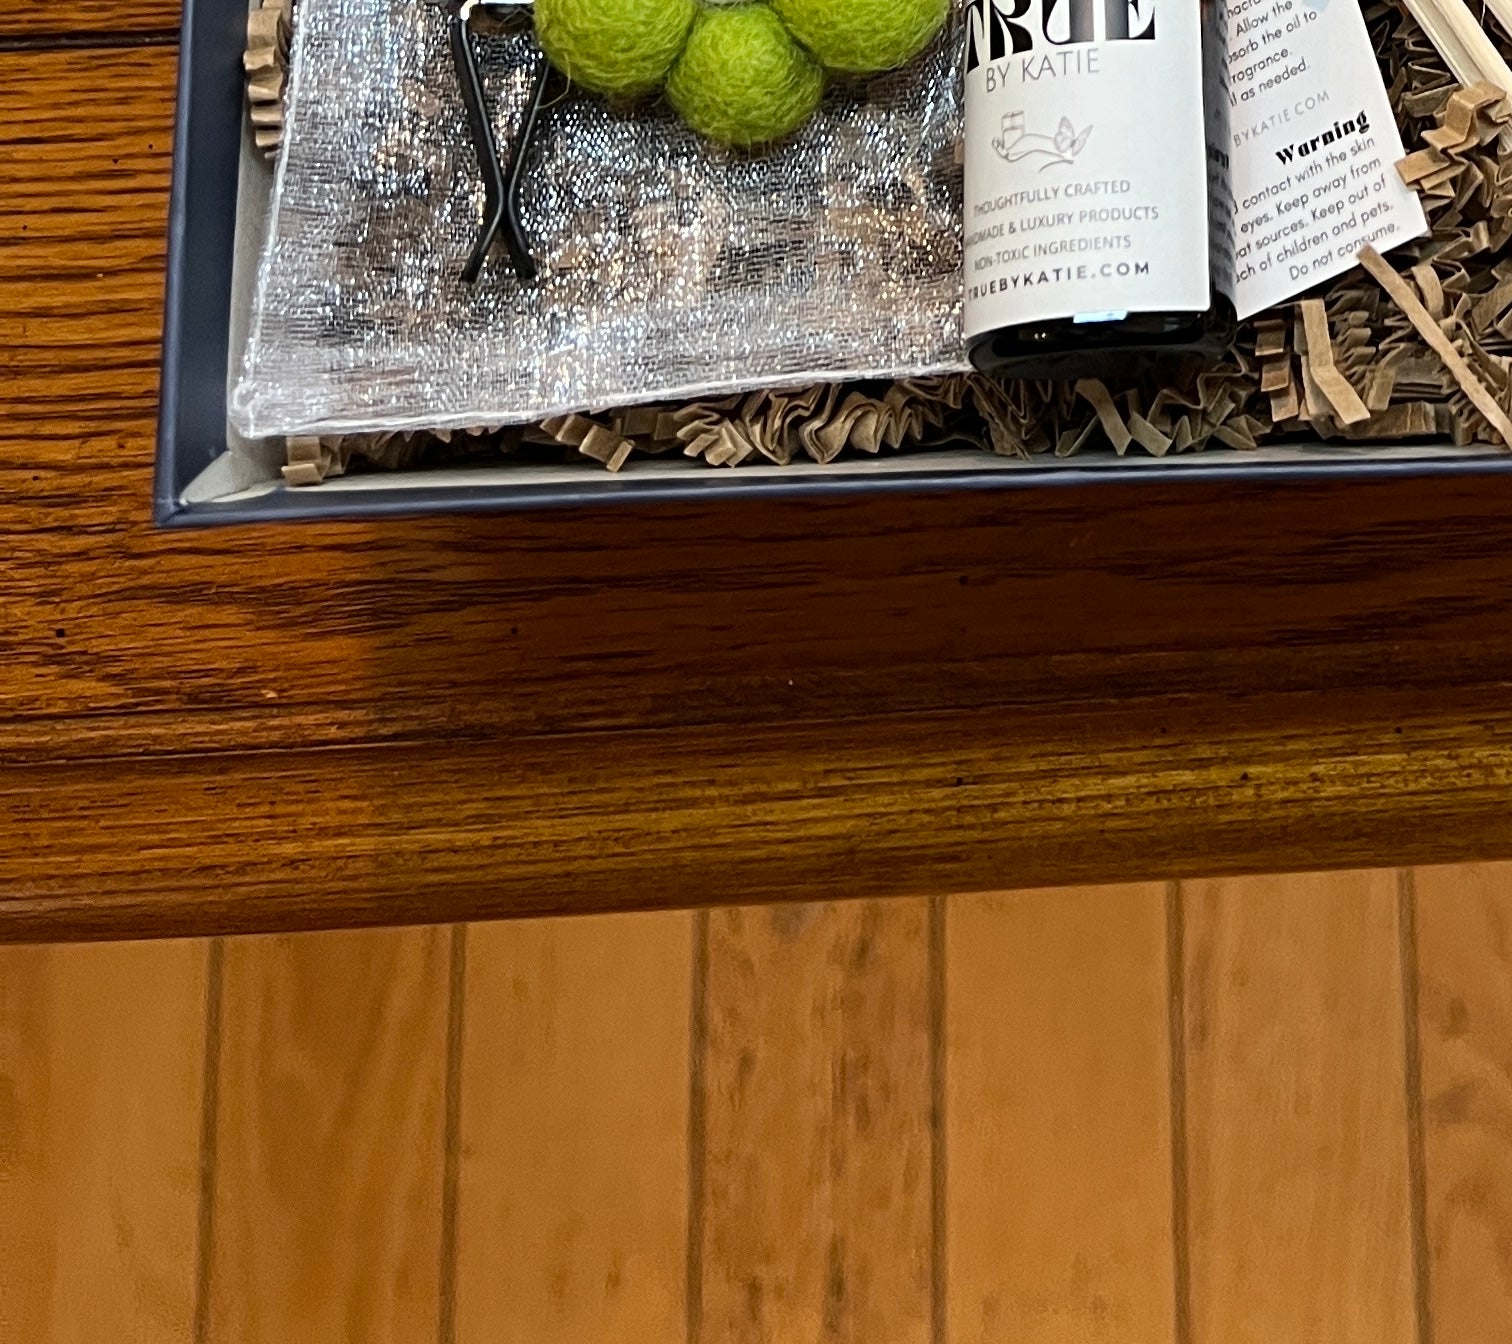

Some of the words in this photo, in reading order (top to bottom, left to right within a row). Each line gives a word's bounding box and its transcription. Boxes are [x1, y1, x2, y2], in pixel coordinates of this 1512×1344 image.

[1236, 12, 1269, 38] Allow
[1272, 0, 1293, 17] the
[1262, 27, 1282, 45] the
[1286, 13, 1300, 33] oil
[1303, 11, 1317, 23] to
[986, 63, 1010, 92] BY
[1022, 48, 1100, 82] KATIE
[1240, 88, 1256, 101] as
[1258, 55, 1311, 93] needed.
[1275, 109, 1370, 166] Warning
[1242, 175, 1292, 210] contact
[1294, 162, 1323, 184] with
[1325, 152, 1347, 170] the
[1350, 136, 1375, 156] skin
[974, 186, 1060, 218] THOUGHTFULLY
[1064, 179, 1131, 197] CRAFTED
[1240, 213, 1274, 235] eyes.
[1276, 194, 1309, 216] Keep
[1312, 173, 1347, 199] away
[1350, 158, 1382, 180] from
[1255, 220, 1309, 250] sources.
[1311, 199, 1345, 222] Keep
[1348, 185, 1369, 205] out
[1373, 174, 1387, 193] of
[1008, 220, 1017, 235] &
[1020, 211, 1074, 232] LUXURY
[1079, 205, 1159, 224] PRODUCTS
[1259, 252, 1272, 271] of
[1276, 231, 1329, 263] children
[1331, 210, 1357, 237] and
[1360, 200, 1393, 227] pets.
[974, 245, 1030, 272] NON-TOXIC
[1034, 235, 1131, 257] INGREDIENTS
[1289, 264, 1309, 281] Do
[1312, 250, 1333, 271] not
[967, 261, 1150, 301] TRUEBYKATIE.COM
